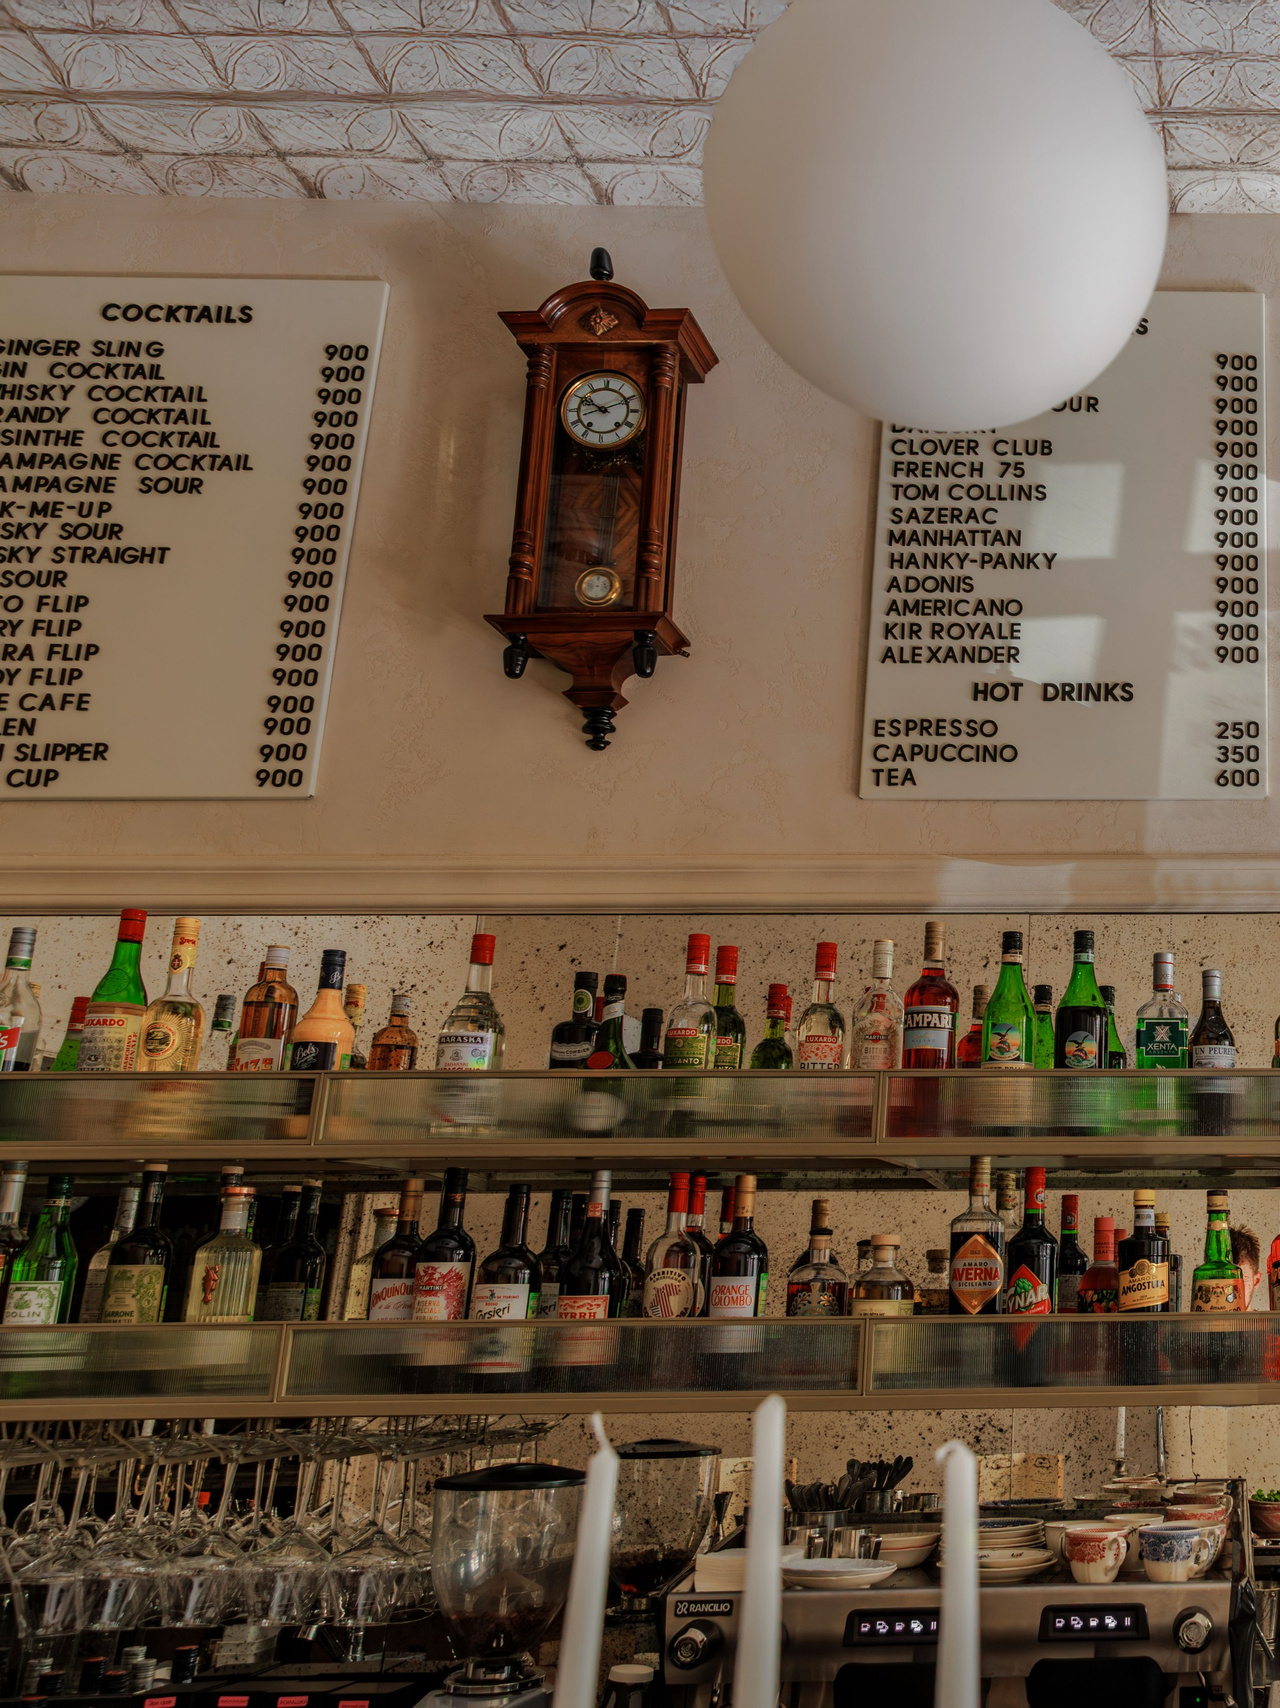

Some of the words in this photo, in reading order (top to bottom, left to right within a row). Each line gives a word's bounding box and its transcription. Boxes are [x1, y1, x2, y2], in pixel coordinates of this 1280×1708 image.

[102, 303, 253, 323] COCKTAILS
[92, 340, 164, 358] SLING
[325, 345, 369, 361] 900
[1216, 354, 1257, 371] 900
[0, 362, 27, 378] IN
[49, 362, 164, 380] COCKTAIL
[321, 366, 365, 383] 900
[1216, 375, 1257, 392] 900
[0, 384, 75, 401] HISKY
[87, 385, 207, 403] COCKTAIL
[318, 388, 361, 405] 900
[1216, 398, 1257, 414] 900
[93, 408, 211, 425] COCKTAIL
[314, 411, 358, 428] 900
[1216, 420, 1257, 436] 900
[102, 430, 220, 448] COCKTAIL
[310, 433, 355, 450] 900
[891, 439, 979, 455] CLOVER
[993, 440, 1052, 456] CLUB
[1216, 442, 1257, 458] 900
[135, 454, 253, 471] COCKTAIL
[307, 455, 351, 472] 900
[893, 461, 983, 478] FRENCH
[1000, 462, 1025, 478] 75
[1215, 464, 1257, 480] 900
[139, 477, 203, 494] SOUR
[303, 478, 347, 495] 900
[892, 484, 939, 500] TOM
[948, 484, 1046, 501] COLLINS
[1215, 486, 1257, 502] 900
[299, 503, 344, 519] 900
[891, 508, 998, 524] SAZERAC
[1215, 509, 1257, 525] 900
[59, 523, 123, 540] SOUR
[295, 525, 340, 543] 900
[888, 530, 1021, 546] MANHATTAN
[1215, 532, 1258, 548] 900
[51, 546, 170, 564] STRAIGHT
[292, 547, 336, 565] 900
[890, 553, 1057, 569] HANKY-PANKY
[1216, 555, 1258, 571] 900
[0, 570, 67, 588] SOUR
[288, 571, 333, 588] 900
[887, 576, 974, 593] ADONIS
[1216, 577, 1258, 594] 900
[0, 595, 23, 613] O
[36, 595, 89, 612] FLIP
[284, 595, 329, 612] 900
[886, 599, 1023, 616] AMERICANO
[1216, 601, 1258, 617] 900
[31, 619, 82, 637] FLIP
[280, 620, 325, 638] 900
[885, 623, 922, 640] KIR
[931, 623, 1020, 640] ROYALE
[1216, 624, 1258, 641] 900
[47, 644, 99, 661] FLIP
[276, 644, 322, 662] 900
[881, 646, 1019, 663] ALEXANDER
[1216, 646, 1258, 663] 900
[29, 668, 83, 686] FLIP
[272, 668, 318, 687] 900
[973, 683, 1023, 702] HOT
[1043, 683, 1133, 702] DRINKS
[19, 693, 91, 711] CAFE
[267, 695, 314, 713] 900
[0, 718, 36, 736] EN
[264, 717, 311, 735] 900
[874, 719, 998, 737] ESPRESSO
[1217, 721, 1259, 739] 250
[14, 743, 108, 762] SLIPPER
[260, 743, 307, 762] 900
[873, 744, 1018, 762] CAPUCCINO
[1217, 745, 1259, 763] 350
[6, 769, 59, 787] CUP
[256, 769, 303, 787] 900
[872, 768, 916, 786] TEA
[1216, 769, 1259, 787] 600
[85, 1018, 125, 1027] UXARDO
[904, 1013, 954, 1029] AMPARI
[440, 1036, 482, 1044] MARASKA
[1147, 1043, 1178, 1051] XENTA
[649, 1270, 686, 1281] APERITIVO
[951, 1267, 1000, 1282] AVERNA
[715, 1284, 750, 1295] ORANGE
[1122, 1279, 1165, 1296] ANGOSTURA
[711, 1290, 752, 1307] COLOMBO
[689, 1603, 730, 1612] RANCILIO
